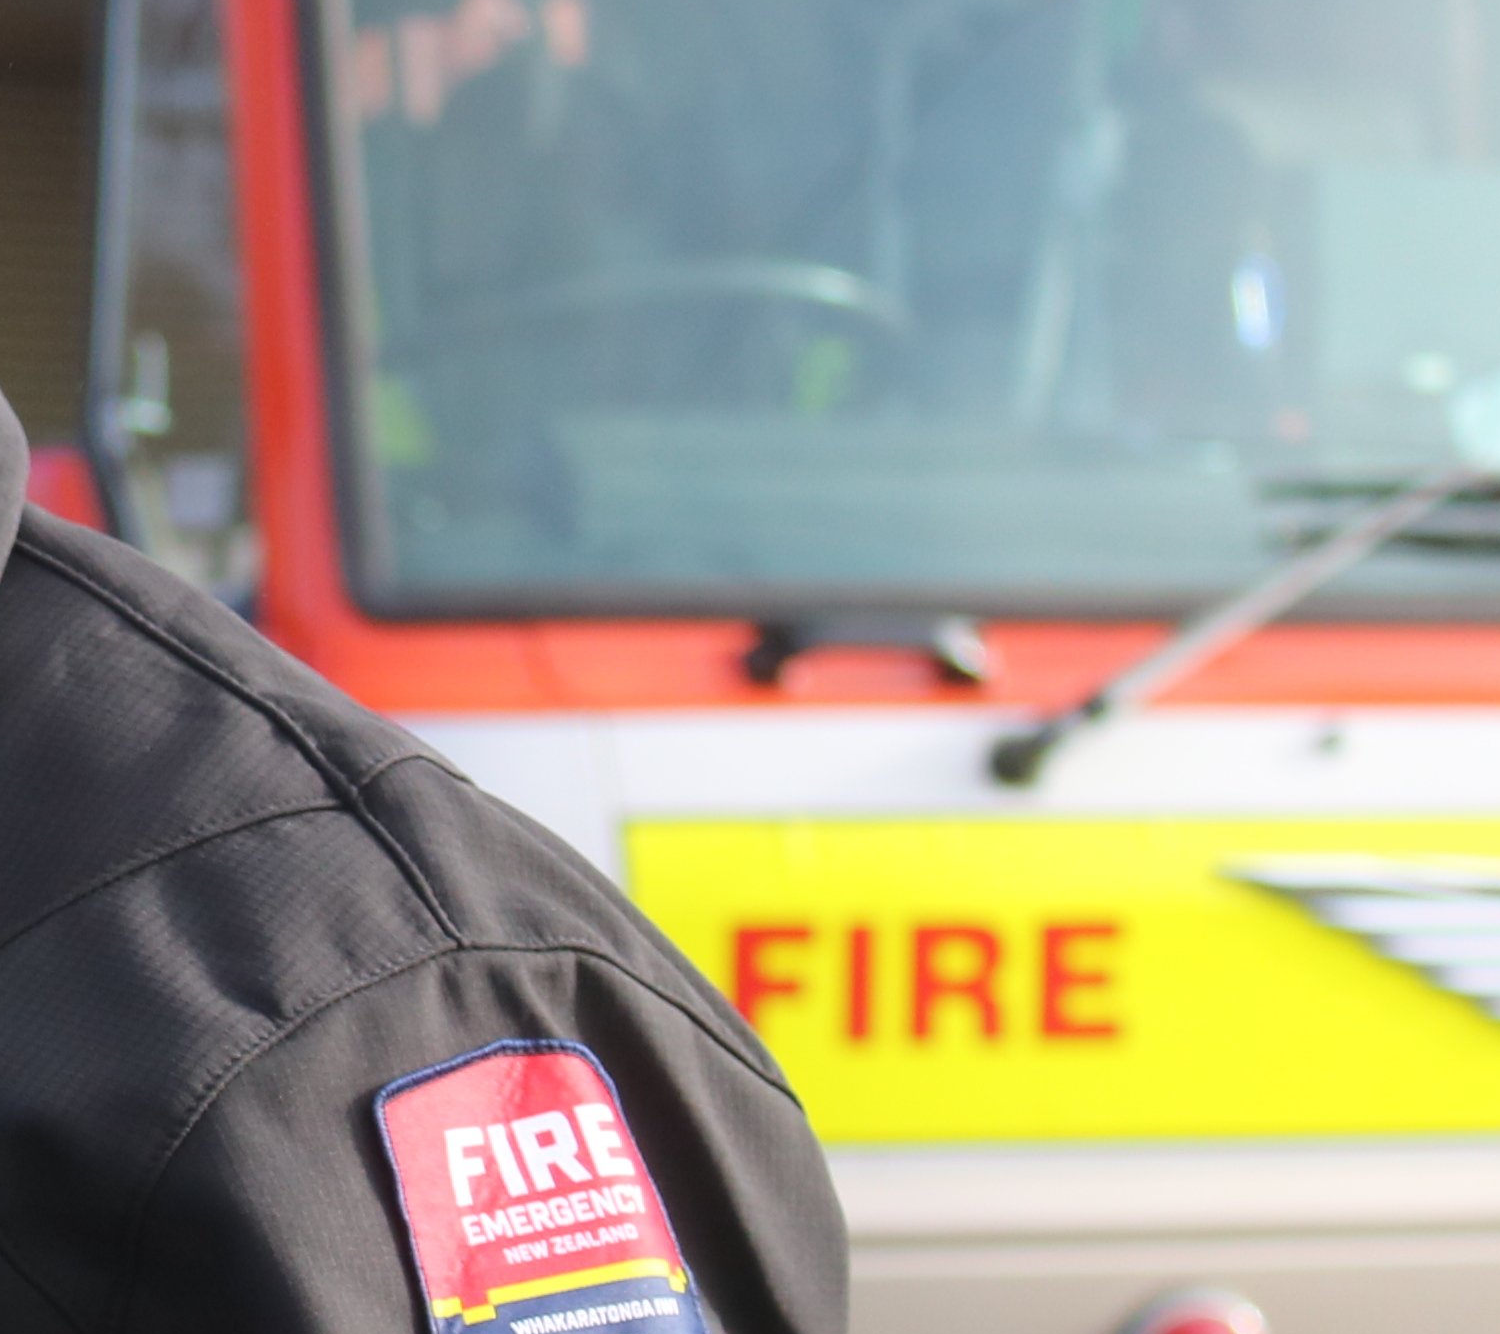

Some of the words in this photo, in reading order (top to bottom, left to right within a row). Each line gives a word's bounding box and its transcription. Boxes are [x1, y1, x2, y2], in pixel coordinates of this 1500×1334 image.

[732, 923, 1120, 1038] FIRE
[444, 1103, 636, 1208] FIRE
[461, 1183, 646, 1246] EMERGENCY
[503, 1240, 549, 1265] NEW
[553, 1223, 640, 1256] ZEALAND
[655, 1297, 681, 1317] IWI
